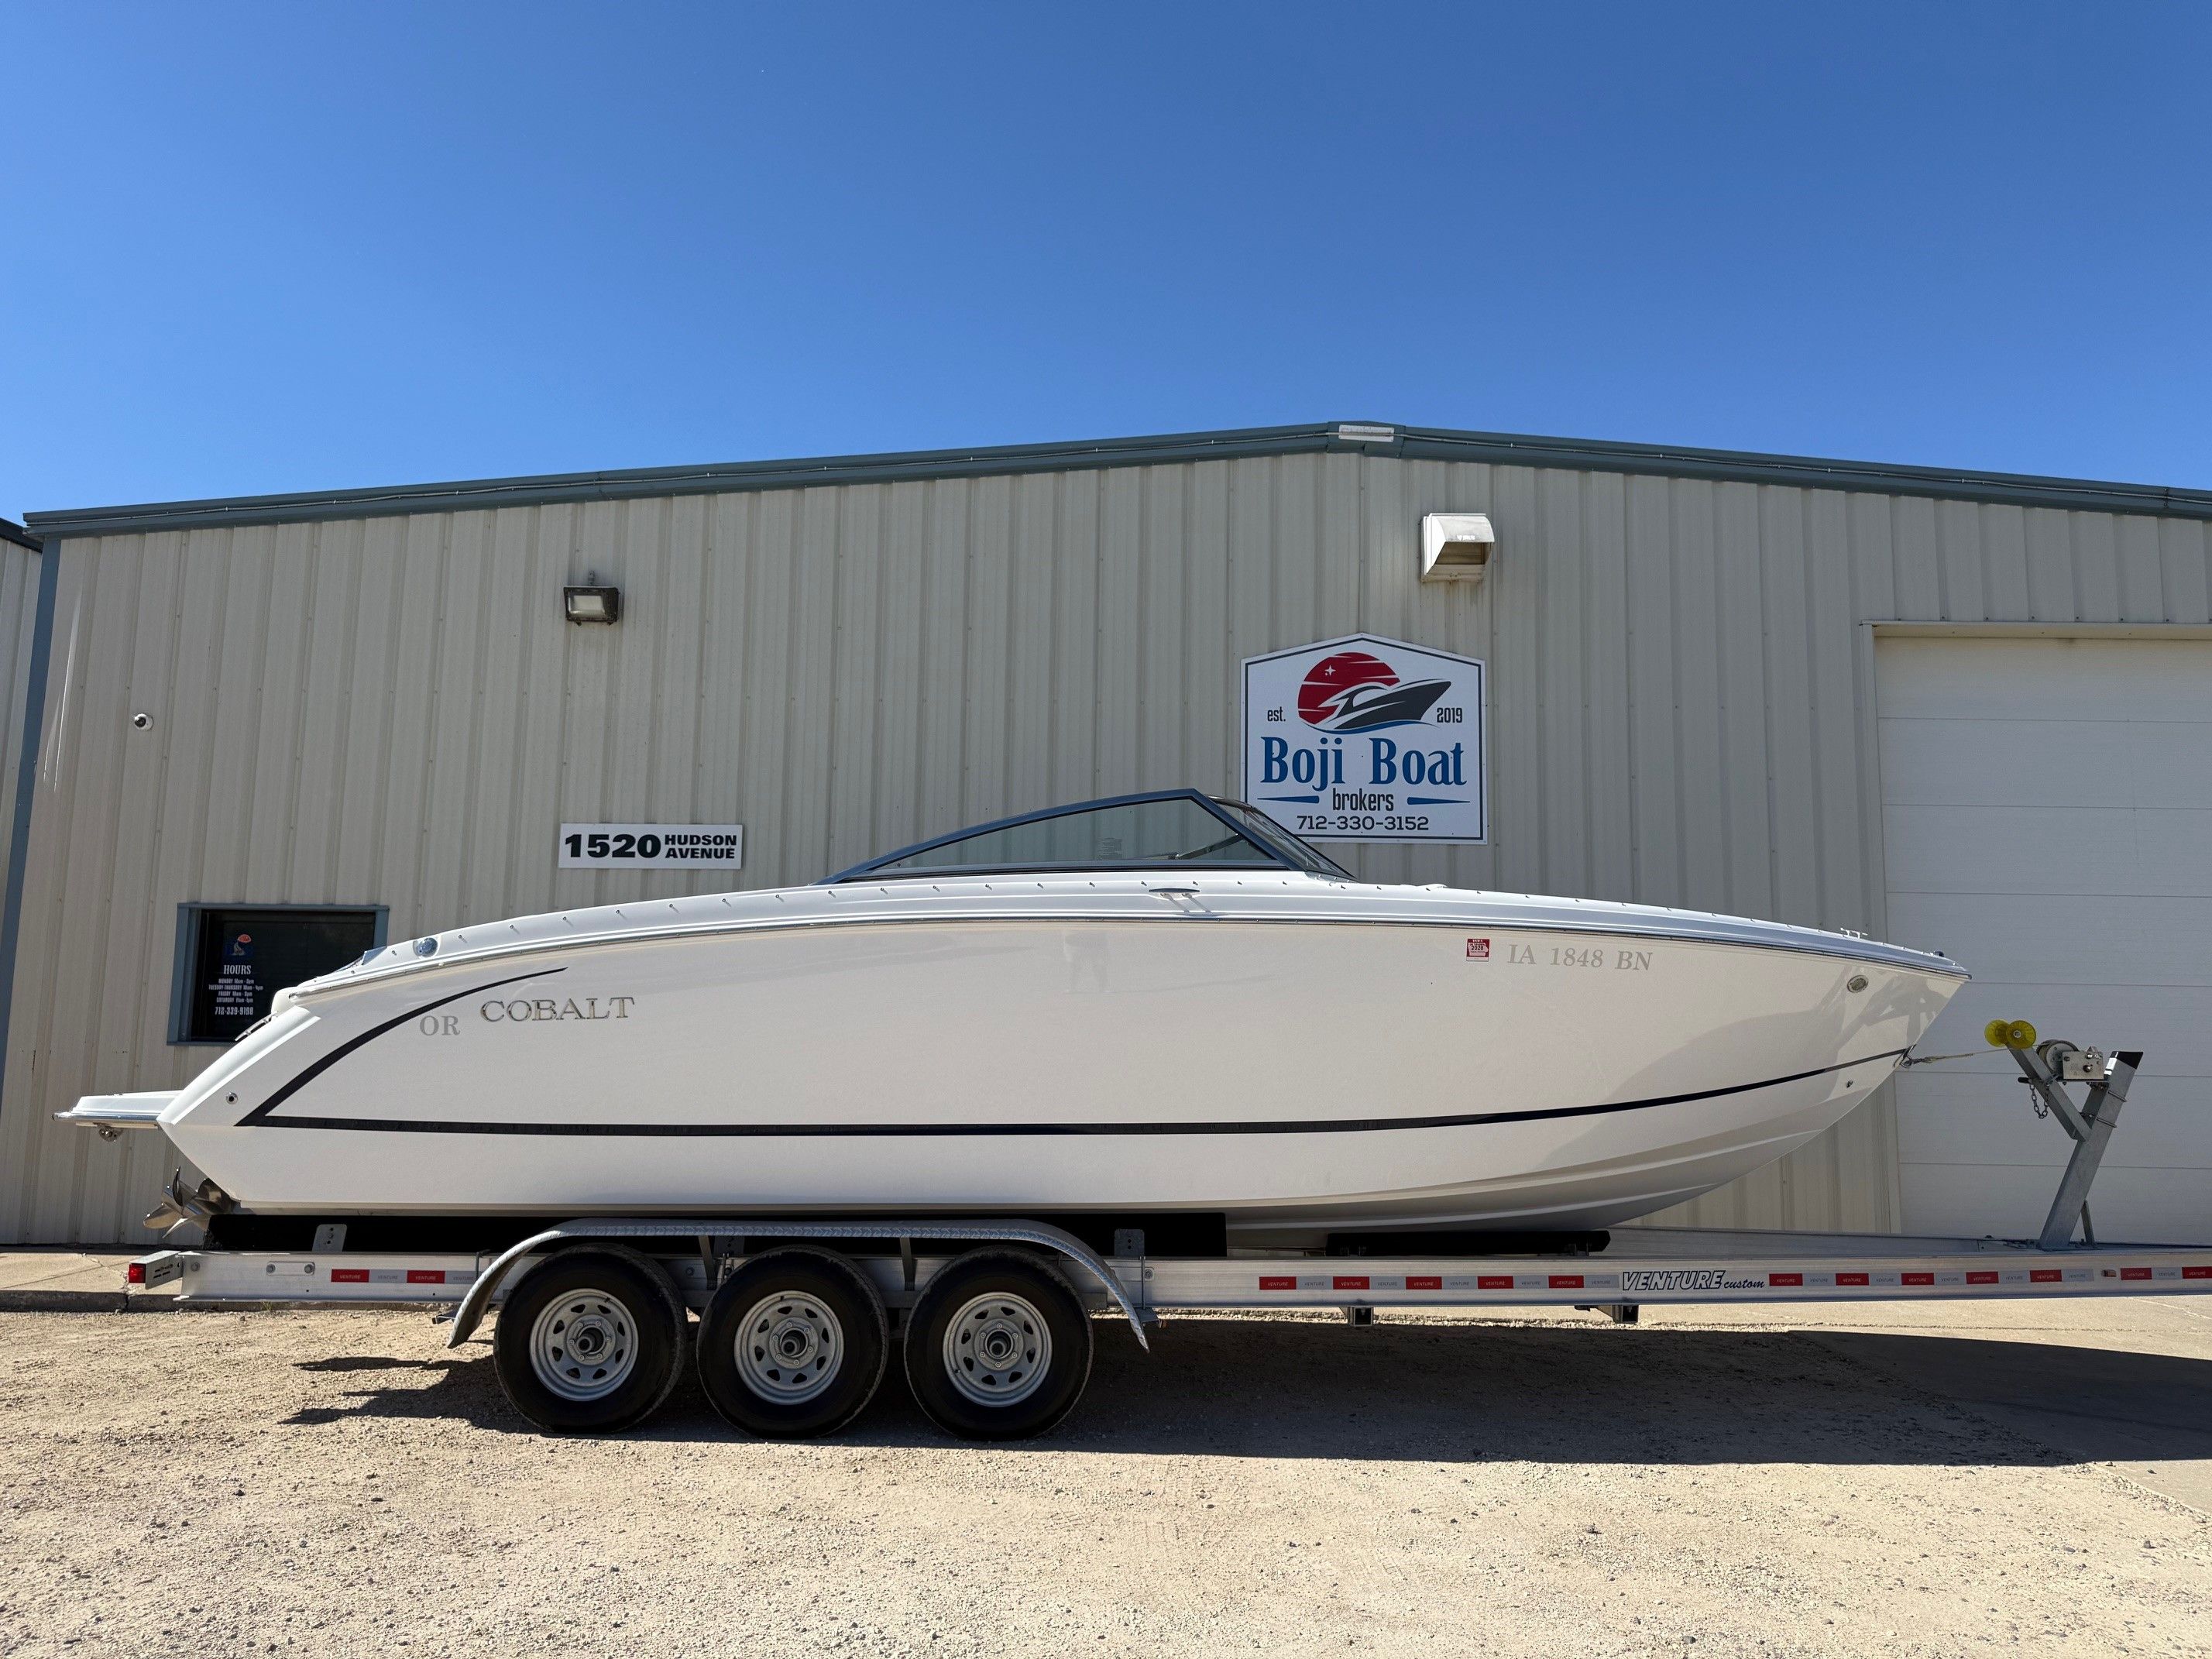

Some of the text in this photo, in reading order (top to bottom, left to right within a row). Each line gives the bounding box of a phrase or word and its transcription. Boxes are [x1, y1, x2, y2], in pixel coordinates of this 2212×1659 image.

[1267, 706, 1286, 722] est.
[1437, 708, 1463, 723] 2019
[1260, 737, 1467, 792] Boji Boat
[1332, 788, 1394, 812] brokers
[1297, 816, 1429, 831] 712-330-3152
[565, 833, 737, 858] 1520 HUDSON
[665, 847, 735, 859] AVENUE
[1507, 943, 1654, 971] IA 1848 BN
[223, 964, 252, 975] HOURS
[479, 996, 635, 1022] COBALT
[419, 1015, 461, 1036] OR
[1622, 1270, 1765, 1291] VENTURE custom
